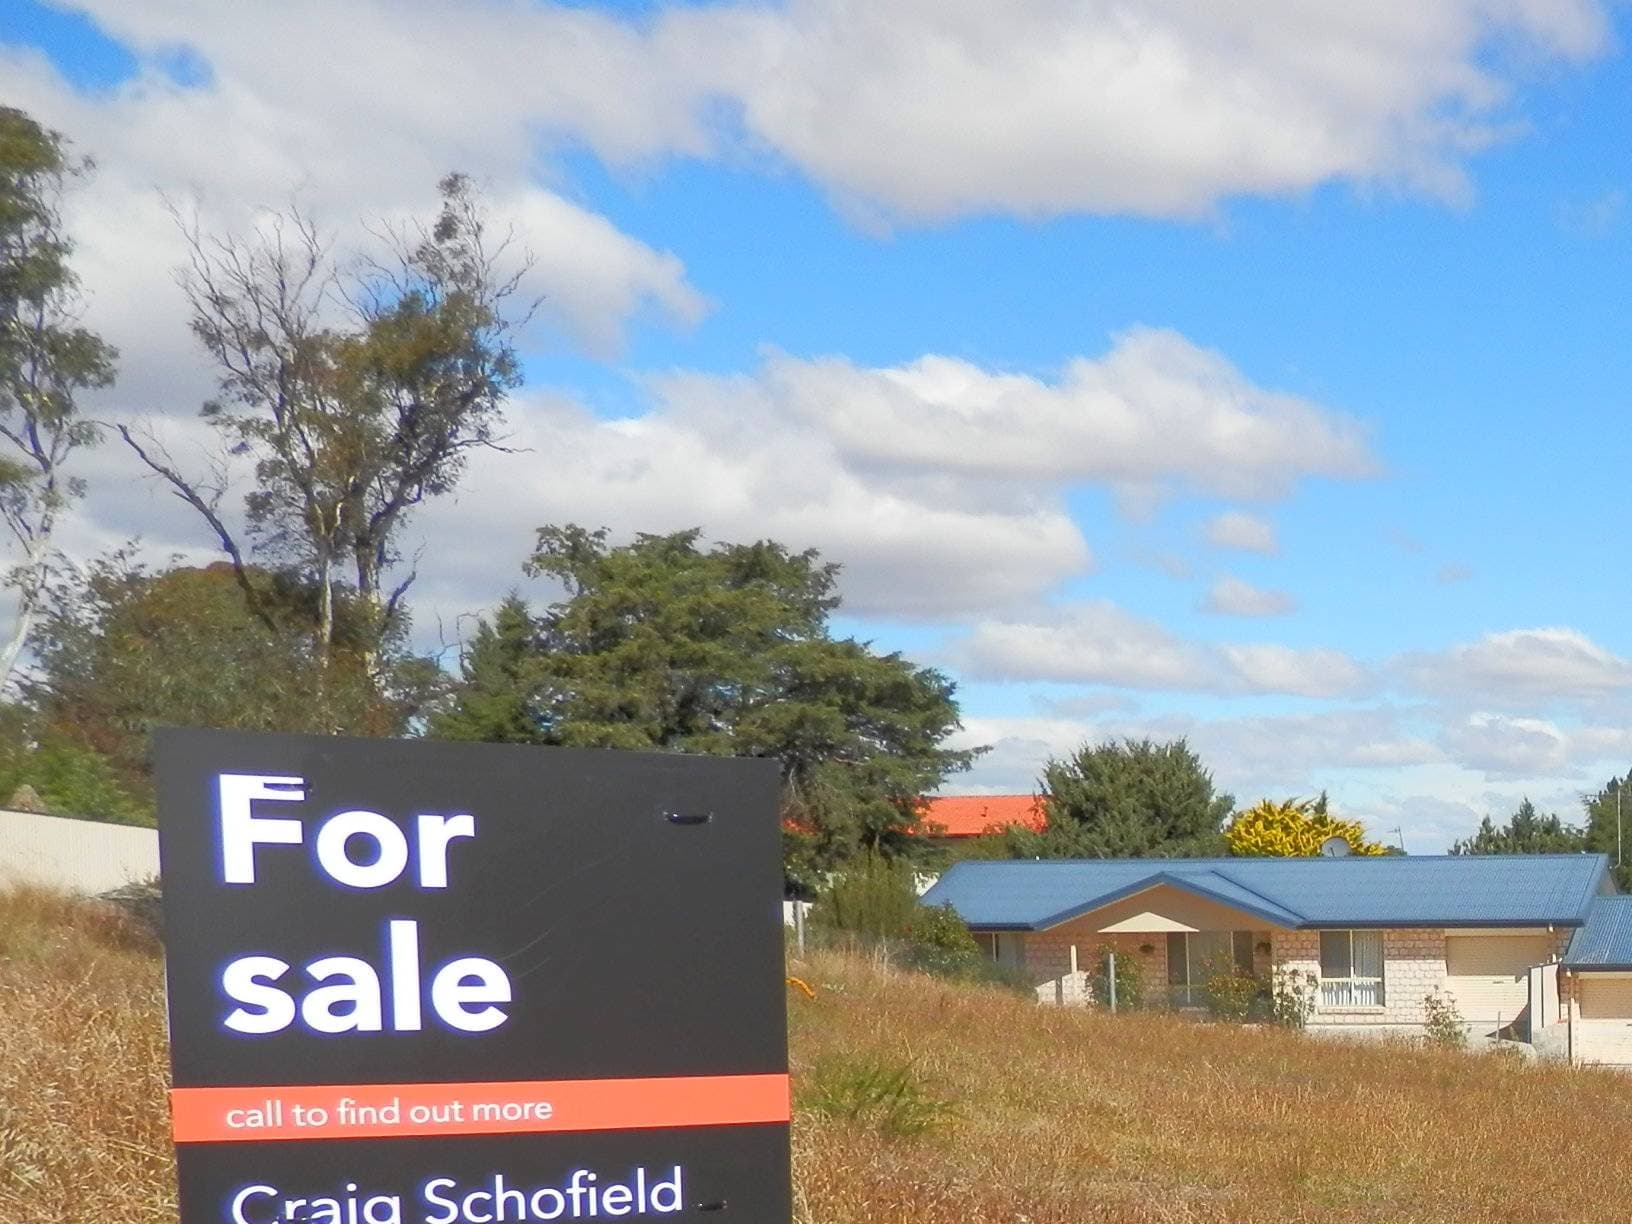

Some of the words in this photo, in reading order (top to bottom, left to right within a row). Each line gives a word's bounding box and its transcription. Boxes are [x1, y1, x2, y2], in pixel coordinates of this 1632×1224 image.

[218, 773, 476, 888] For
[221, 919, 513, 1035] sale
[226, 1101, 283, 1129] call
[291, 1104, 329, 1127] to
[336, 1098, 400, 1125] find
[409, 1097, 465, 1123] out
[472, 1093, 553, 1120] more
